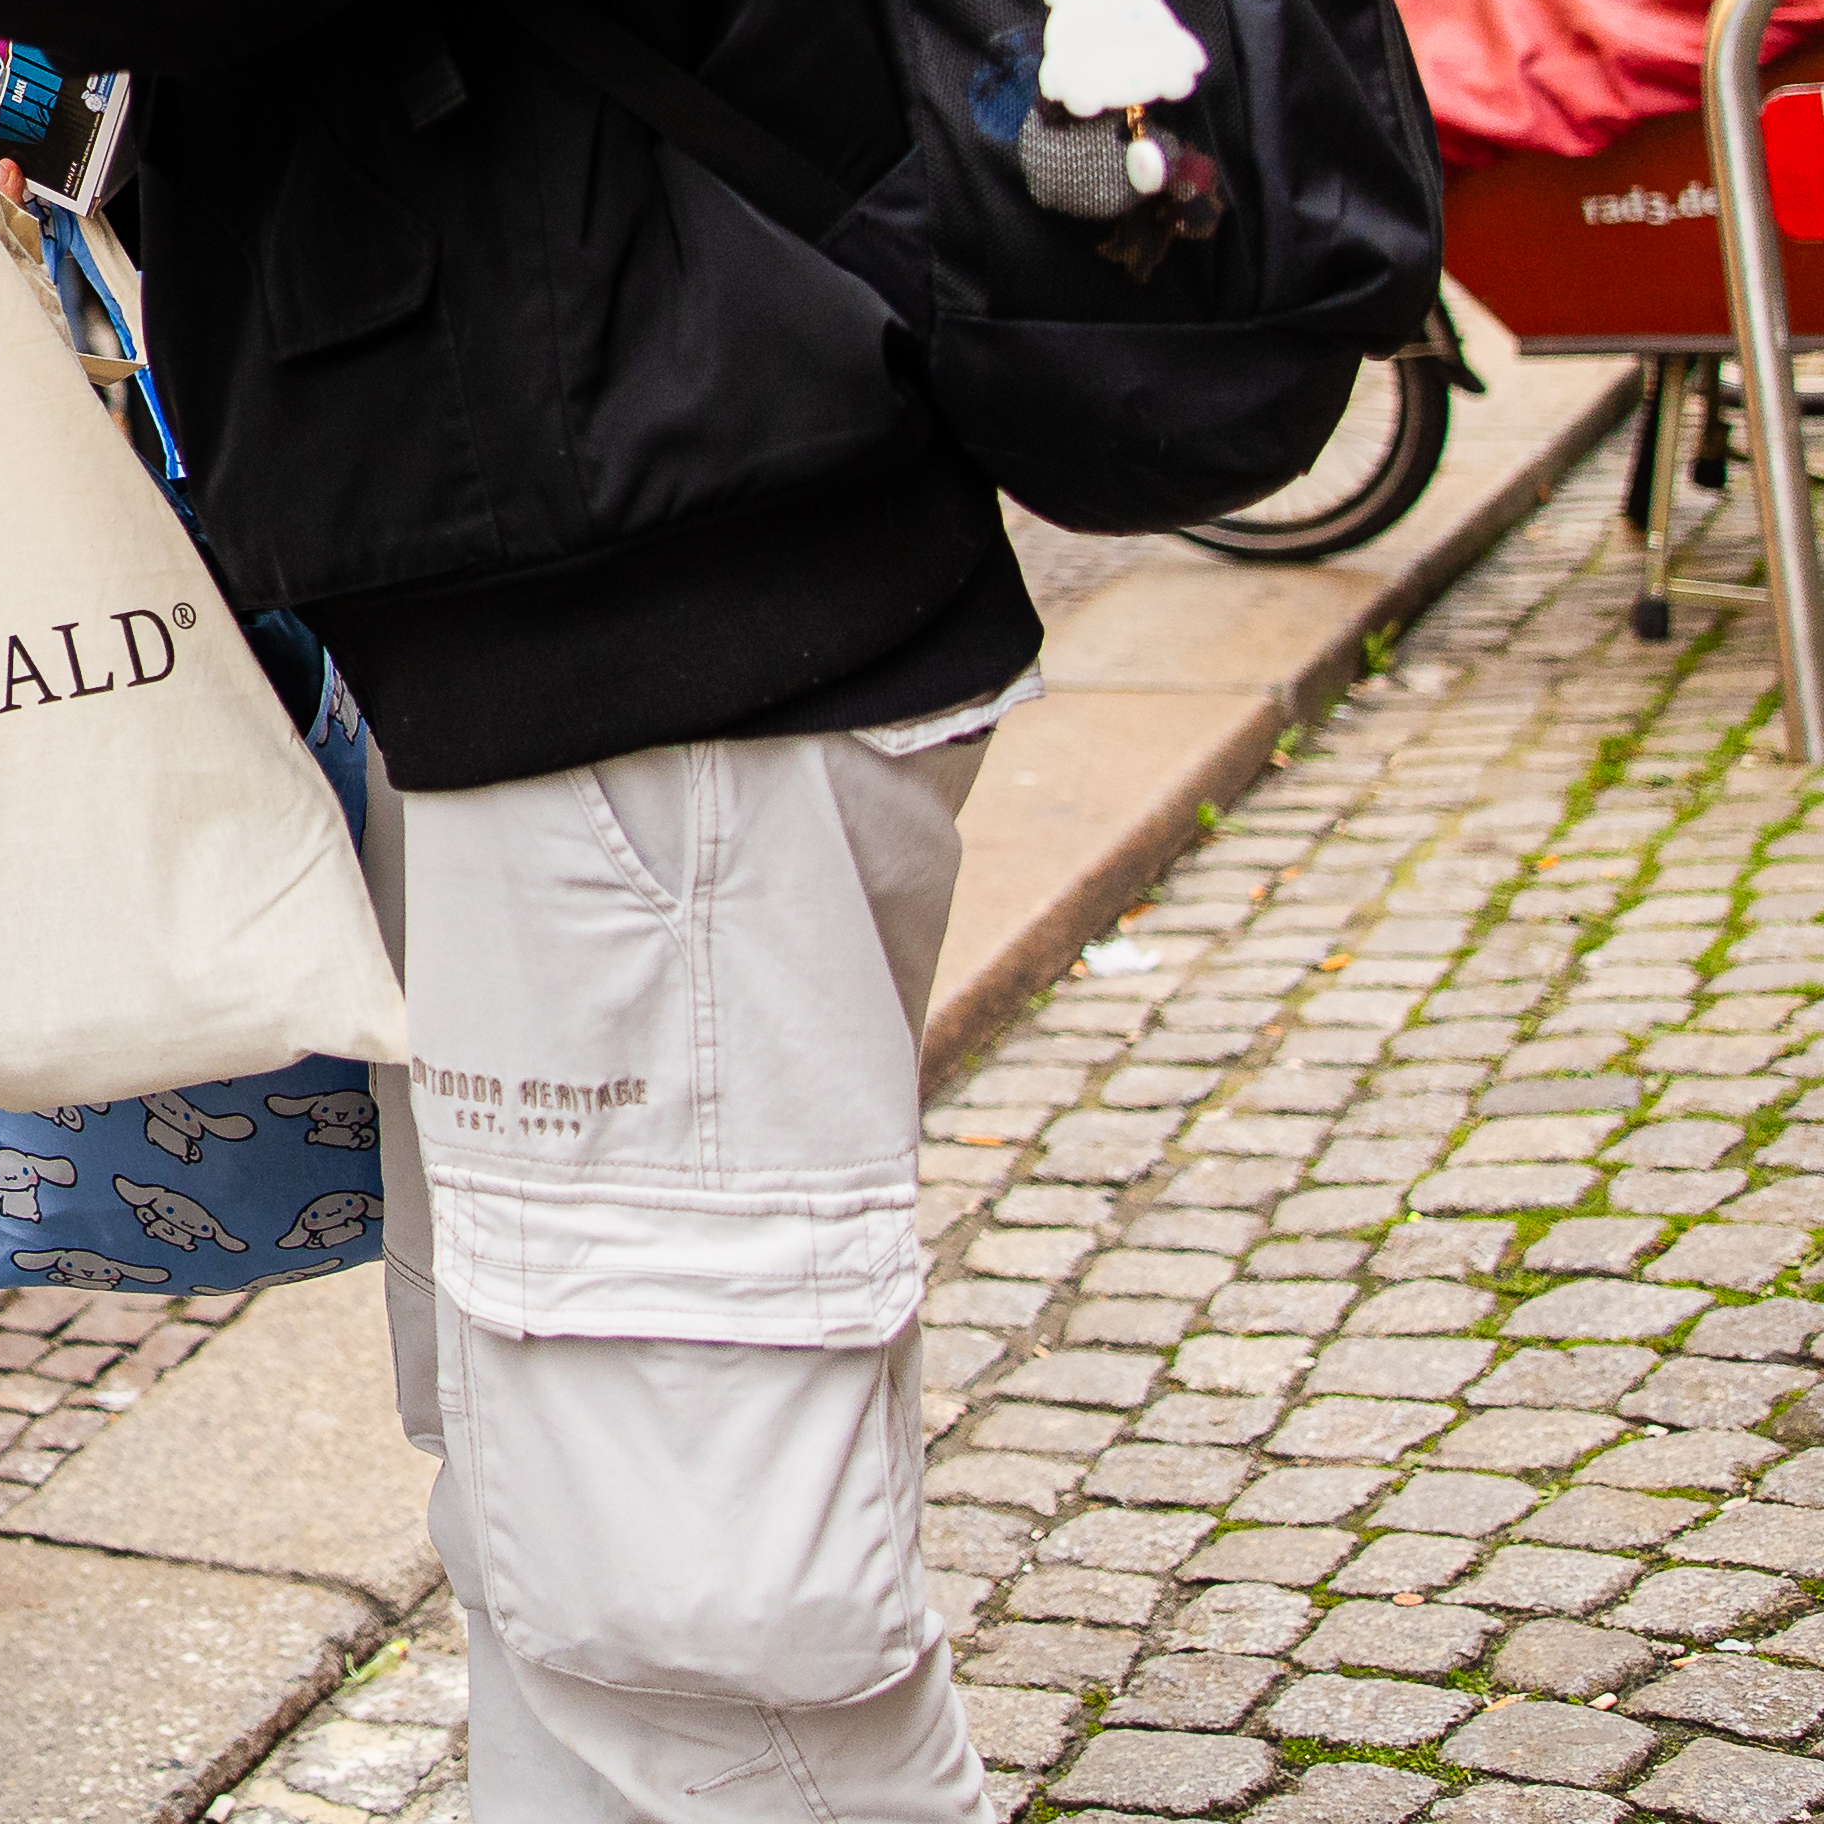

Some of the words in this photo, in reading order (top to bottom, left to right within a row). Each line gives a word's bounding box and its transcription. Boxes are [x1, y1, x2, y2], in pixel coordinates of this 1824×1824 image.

[518, 1077, 648, 1113] HERITAGE
[455, 1109, 505, 1135] EST.
[518, 1117, 581, 1138] 1999
